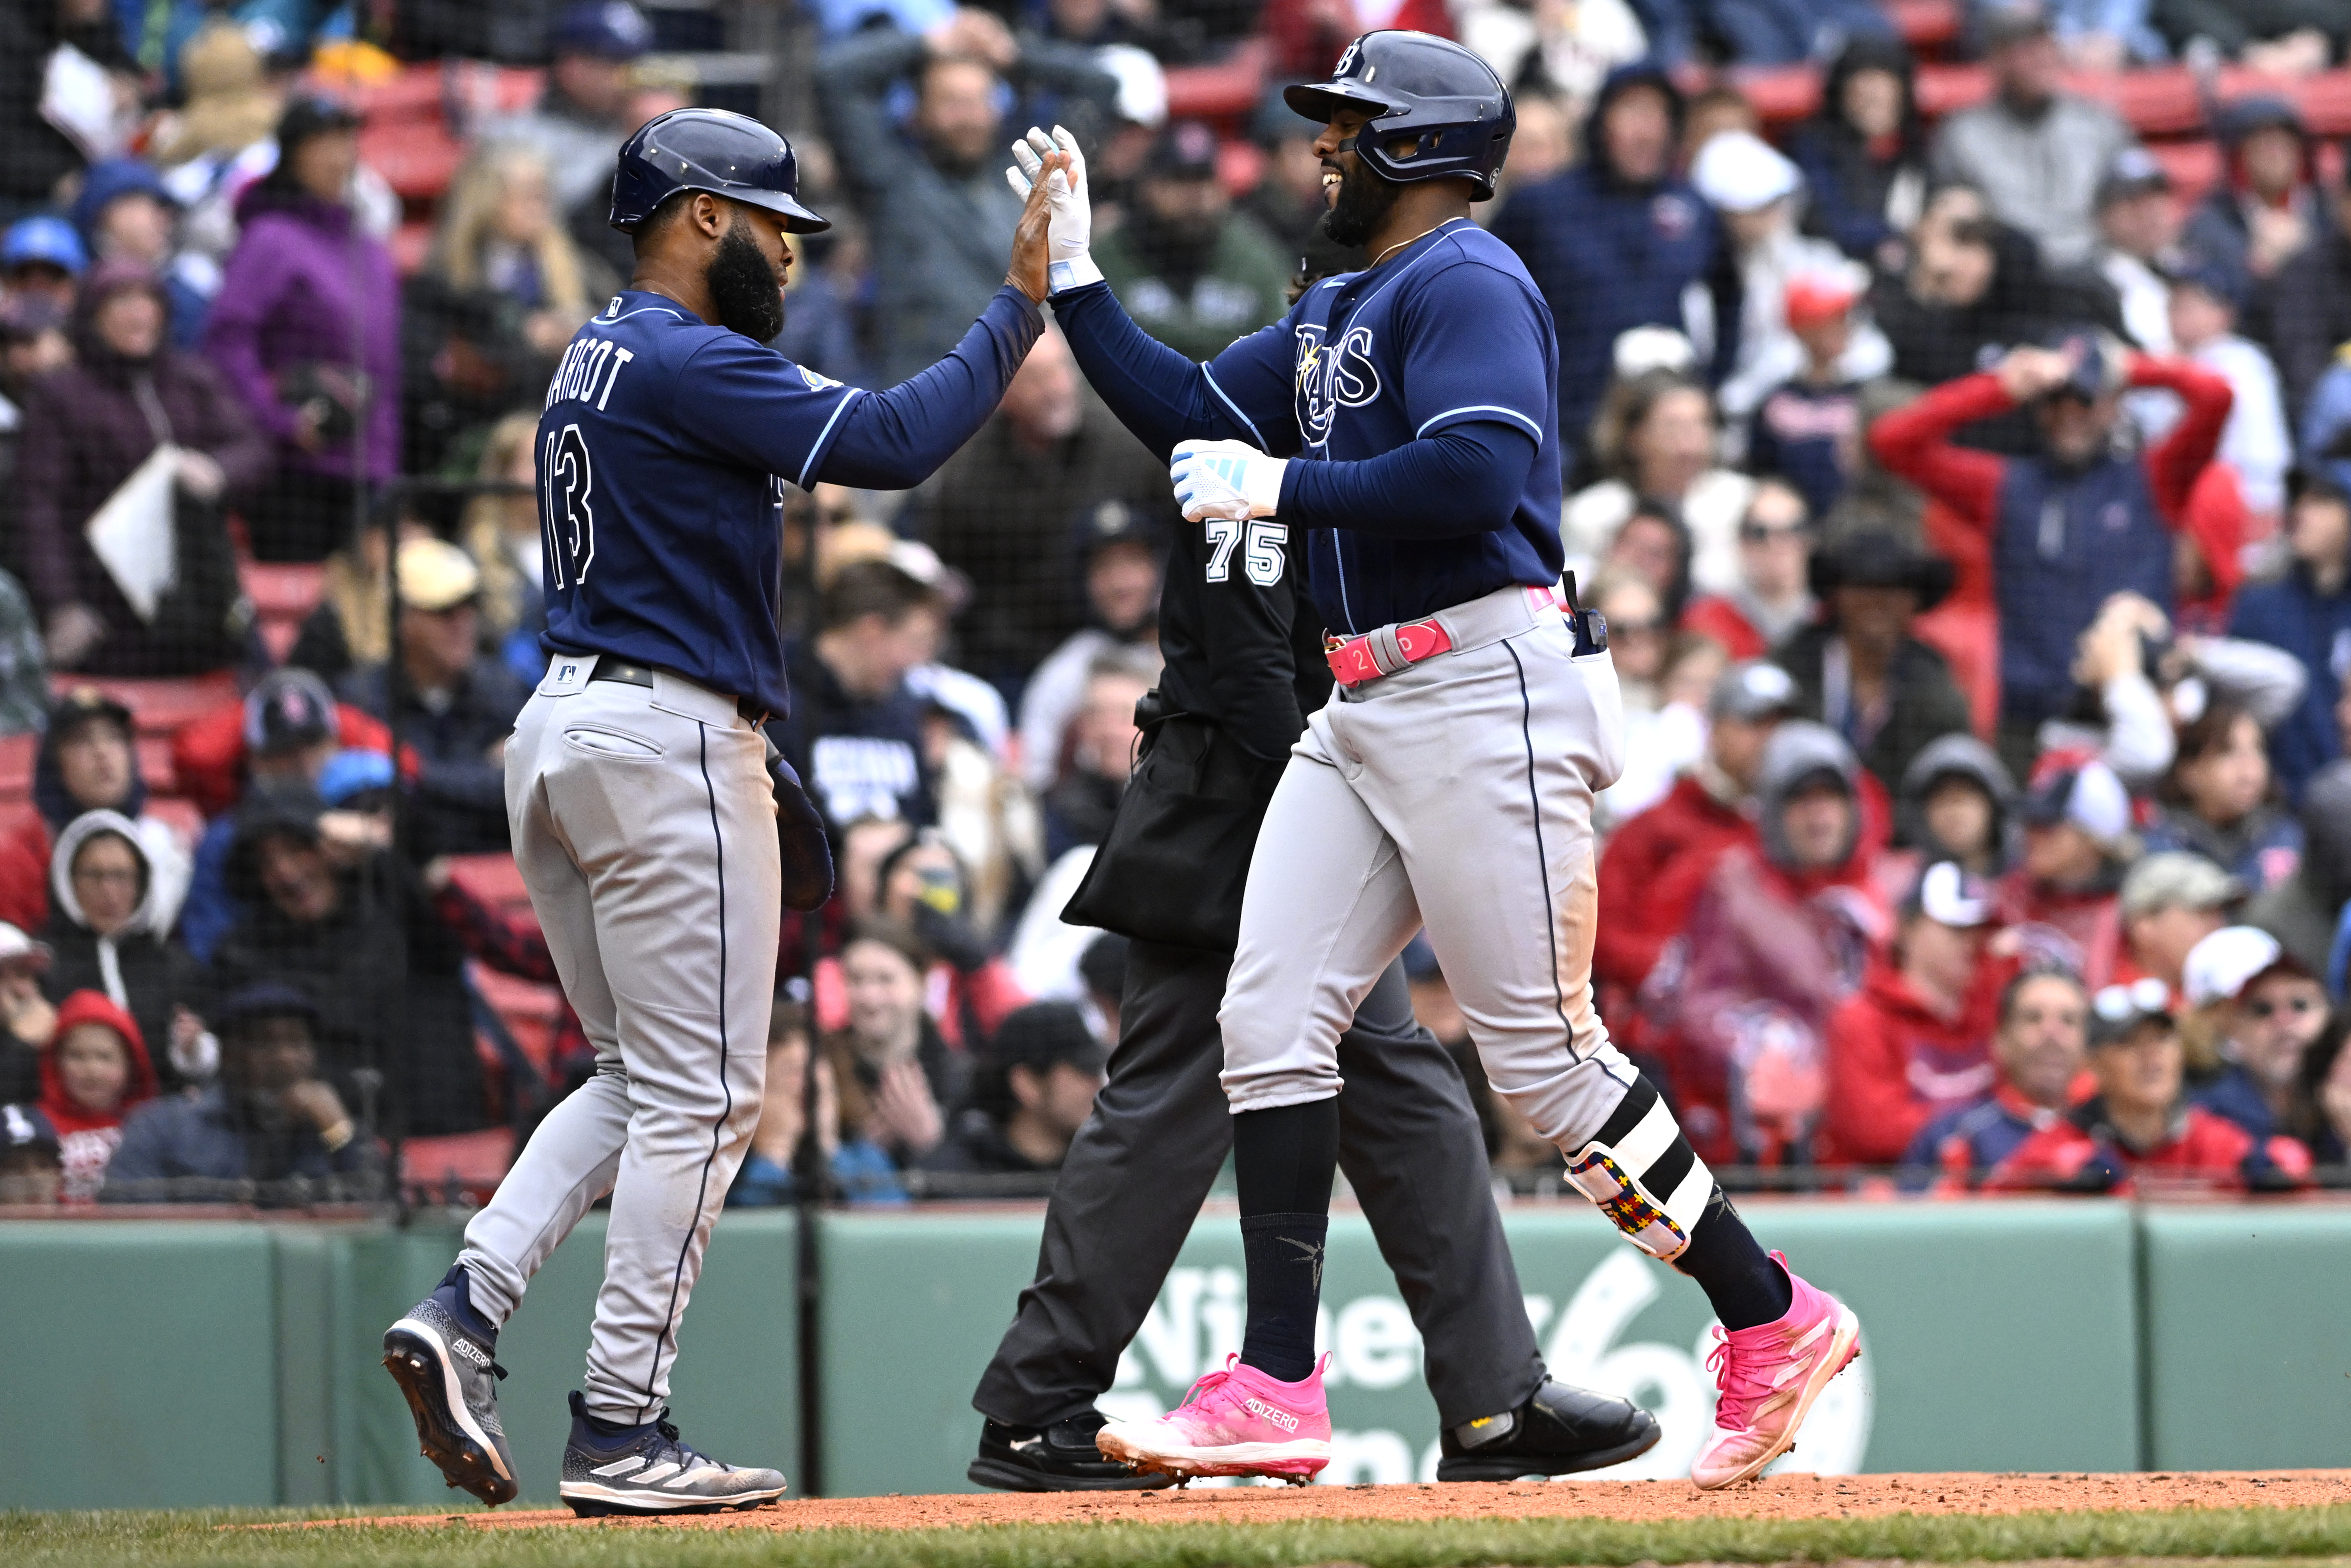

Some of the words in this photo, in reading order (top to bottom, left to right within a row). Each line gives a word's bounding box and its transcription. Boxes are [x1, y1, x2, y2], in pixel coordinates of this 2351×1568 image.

[545, 424, 594, 591] 13
[1205, 517, 1288, 587] 75
[1353, 650, 1368, 670] 2
[1245, 1398, 1299, 1430] ADIZERO
